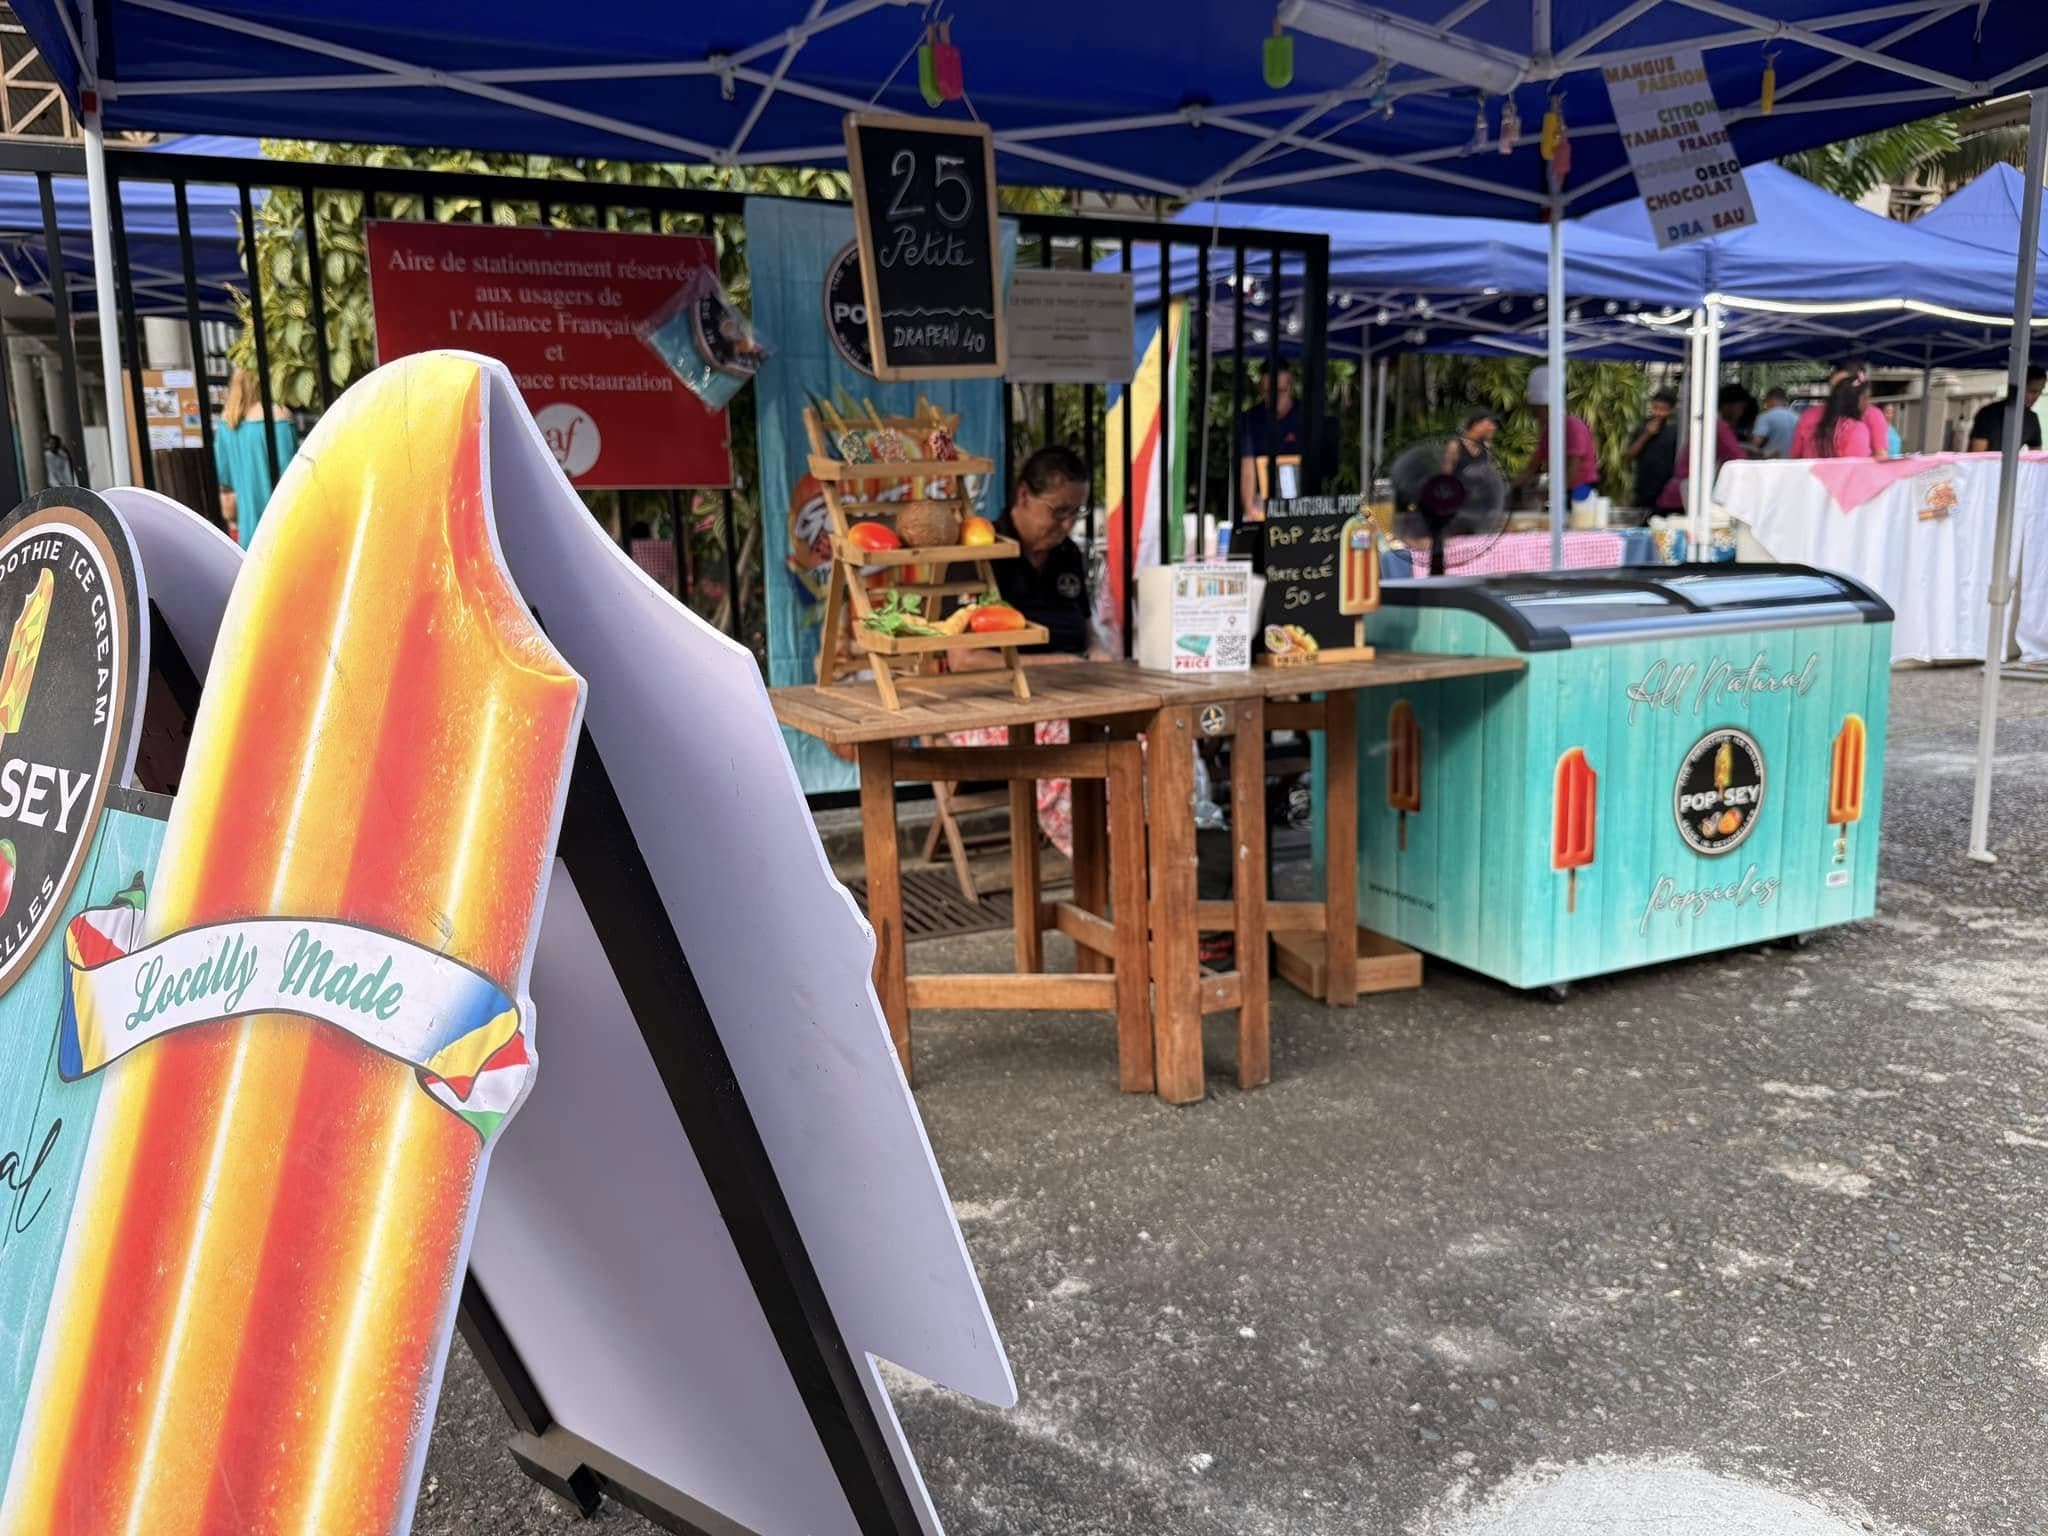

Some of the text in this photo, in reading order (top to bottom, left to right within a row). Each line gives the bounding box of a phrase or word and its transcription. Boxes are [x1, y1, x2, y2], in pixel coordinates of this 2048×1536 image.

[1605, 56, 1676, 82] MANGUE
[1637, 67, 1707, 94] PASSION
[1657, 99, 1719, 124] CITRON
[1623, 120, 1699, 148] TAMARIN
[1678, 131, 1729, 152] FRAISE
[1695, 159, 1741, 181] OREO
[887, 149, 973, 224] 25
[1645, 177, 1734, 211] CHOCOLAT
[879, 225, 975, 268] Petite
[389, 249, 435, 271] Aire
[440, 252, 466, 272] de
[472, 252, 612, 278] stationnement
[475, 287, 622, 311] aux usagers de
[449, 311, 552, 334] l'Alliance
[893, 322, 986, 352] DRAPEAU 40
[544, 343, 565, 362] et
[559, 371, 673, 393] restauration
[1267, 499, 1288, 518] ALL
[1289, 496, 1337, 516] NATURAL
[69, 550, 95, 593] ICE
[91, 594, 113, 727] CREAM
[1175, 659, 1211, 669] PRICE
[1626, 652, 1818, 726] All Natural
[1680, 783, 1761, 813] POP SEY
[1640, 864, 1782, 937] Popsicles
[125, 928, 404, 1031] Locally Made
